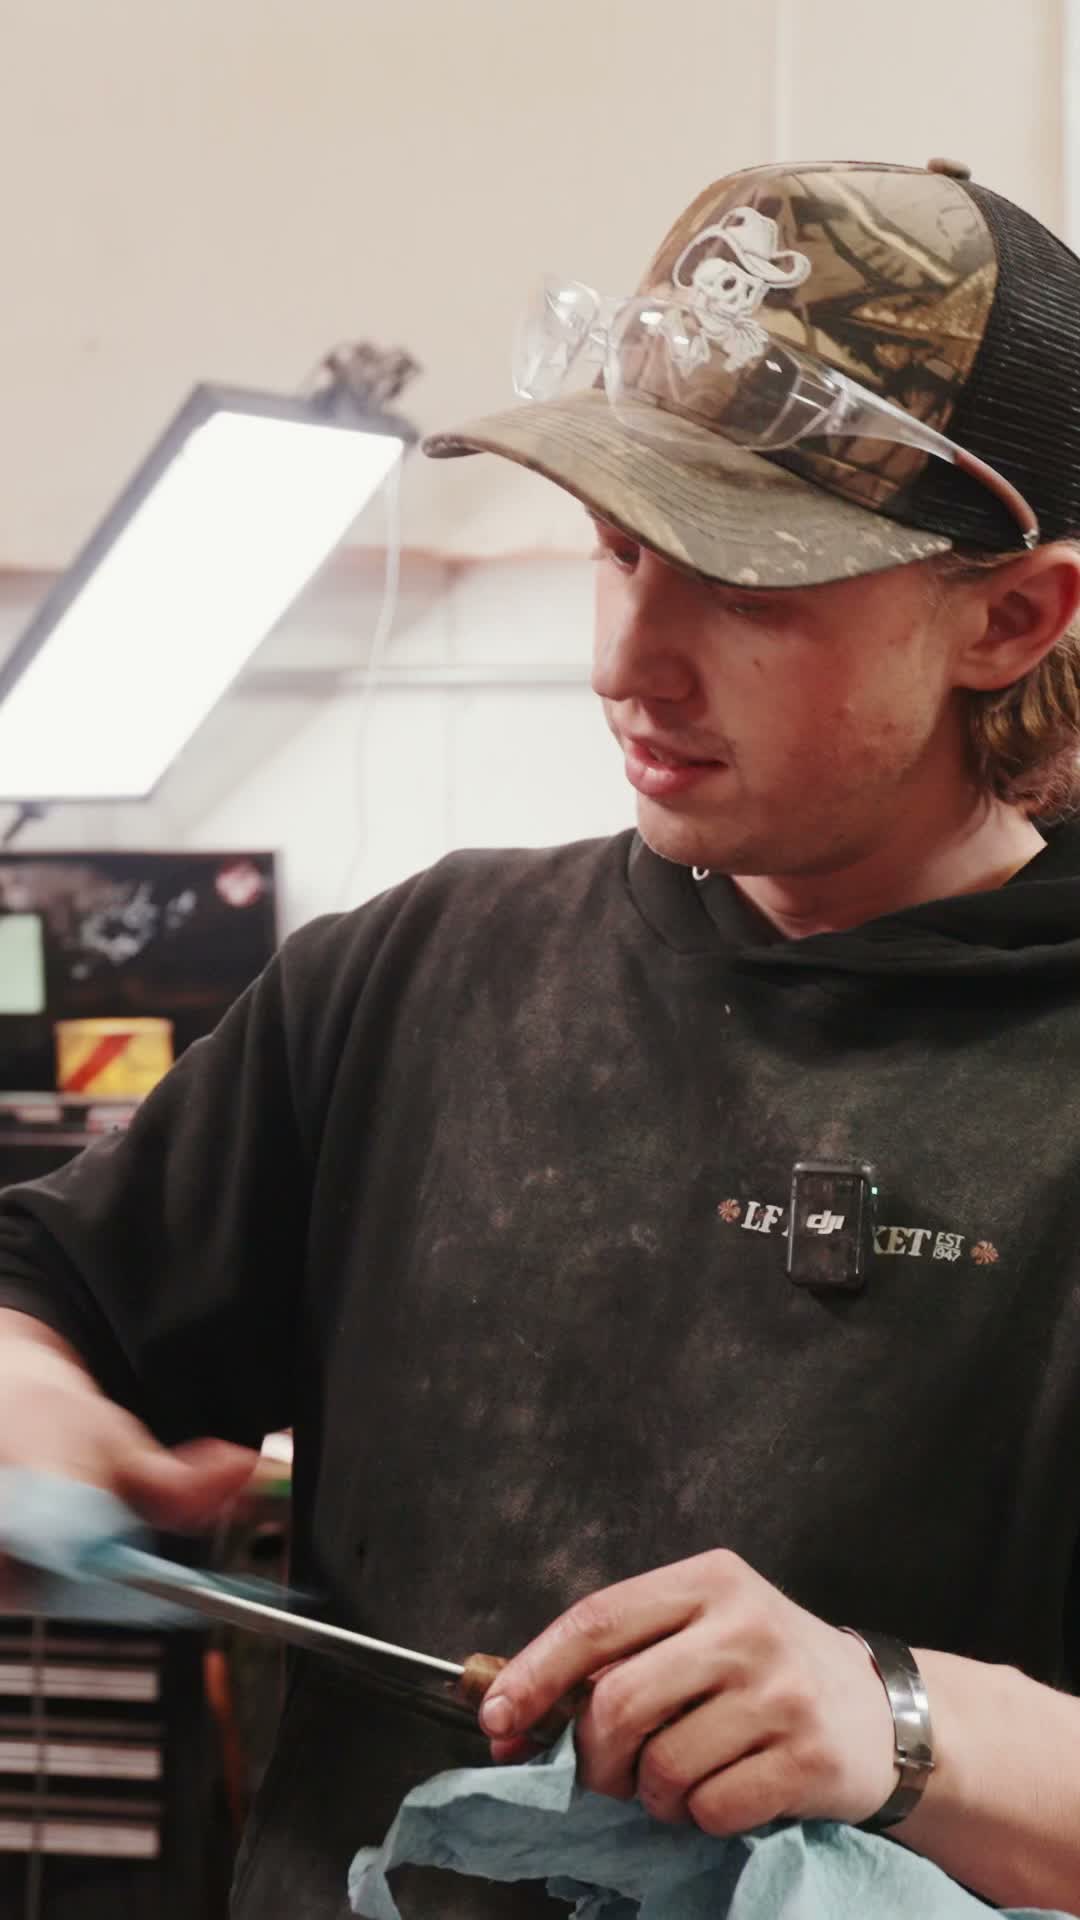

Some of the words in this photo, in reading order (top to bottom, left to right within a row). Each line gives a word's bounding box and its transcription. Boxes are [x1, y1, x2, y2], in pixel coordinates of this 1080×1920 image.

[741, 1200, 784, 1233] LF
[936, 1231, 965, 1249] EST
[933, 1246, 961, 1262] 1947
